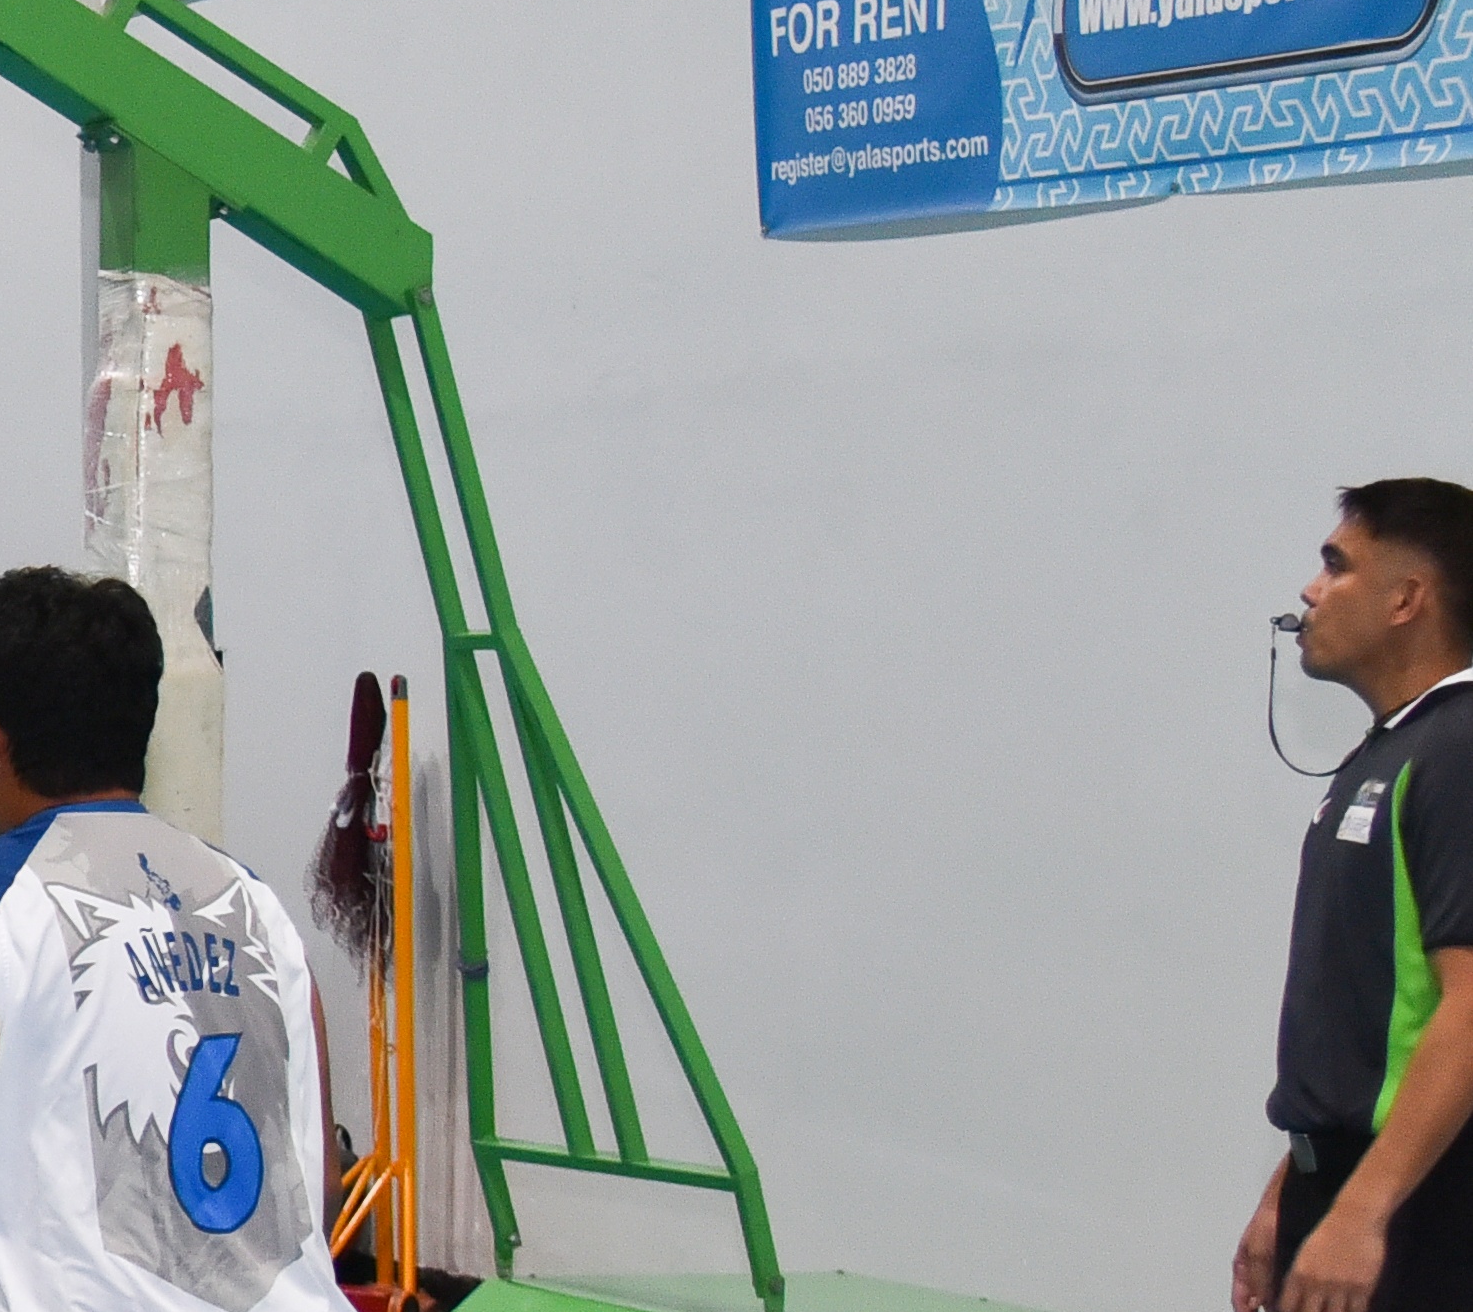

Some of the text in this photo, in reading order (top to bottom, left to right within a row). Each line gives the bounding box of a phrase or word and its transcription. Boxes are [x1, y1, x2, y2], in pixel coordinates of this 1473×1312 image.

[803, 53, 917, 94] 050 889 3828
[805, 93, 916, 133] 056 360 0959
[770, 135, 989, 186] register@yalasports.com
[124, 927, 241, 997] AÑEDEZ
[167, 1031, 265, 1234] 6
